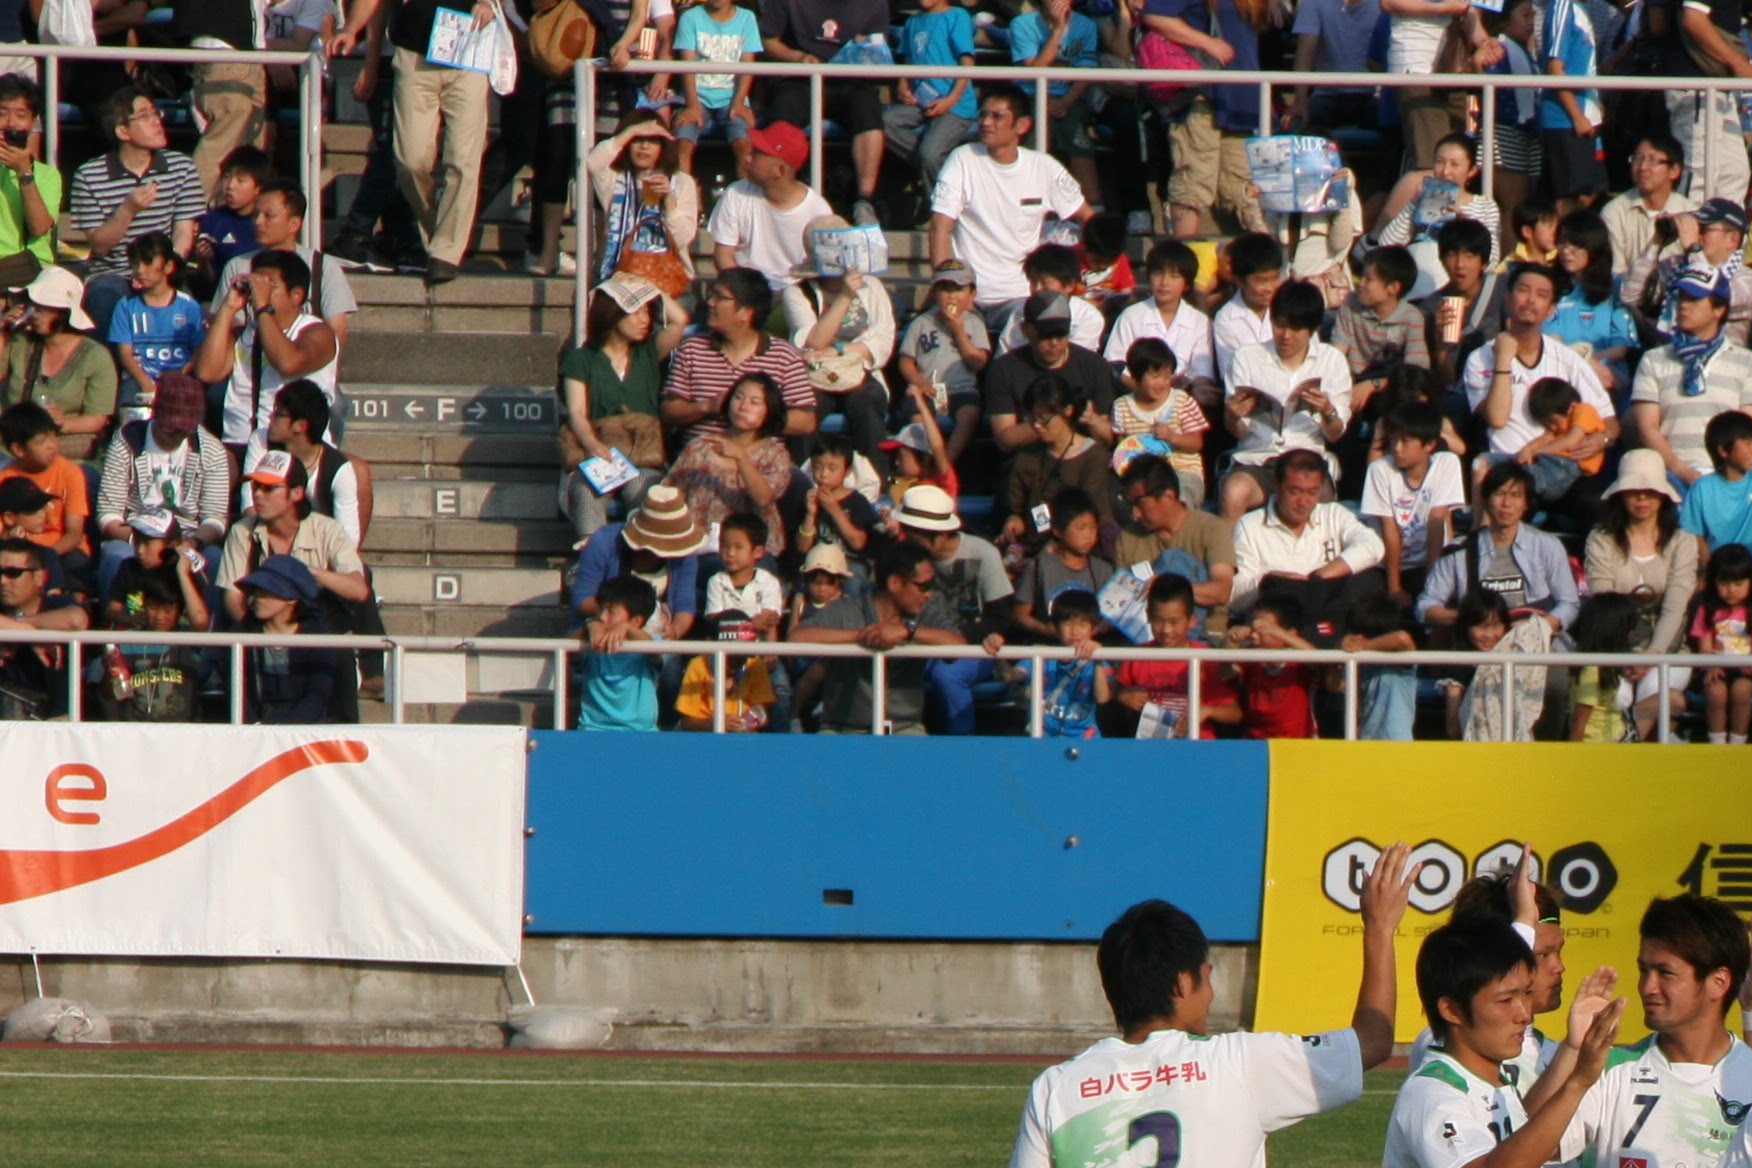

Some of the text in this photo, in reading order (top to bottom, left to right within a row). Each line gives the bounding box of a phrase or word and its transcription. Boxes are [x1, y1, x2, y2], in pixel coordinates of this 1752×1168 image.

[351, 399, 541, 421] 101 F 100
[436, 489, 456, 513] E
[435, 575, 459, 600] D
[45, 763, 107, 825] e
[1080, 1061, 1207, 1099] 白バラ牛乳
[1621, 1094, 1661, 1149] 7
